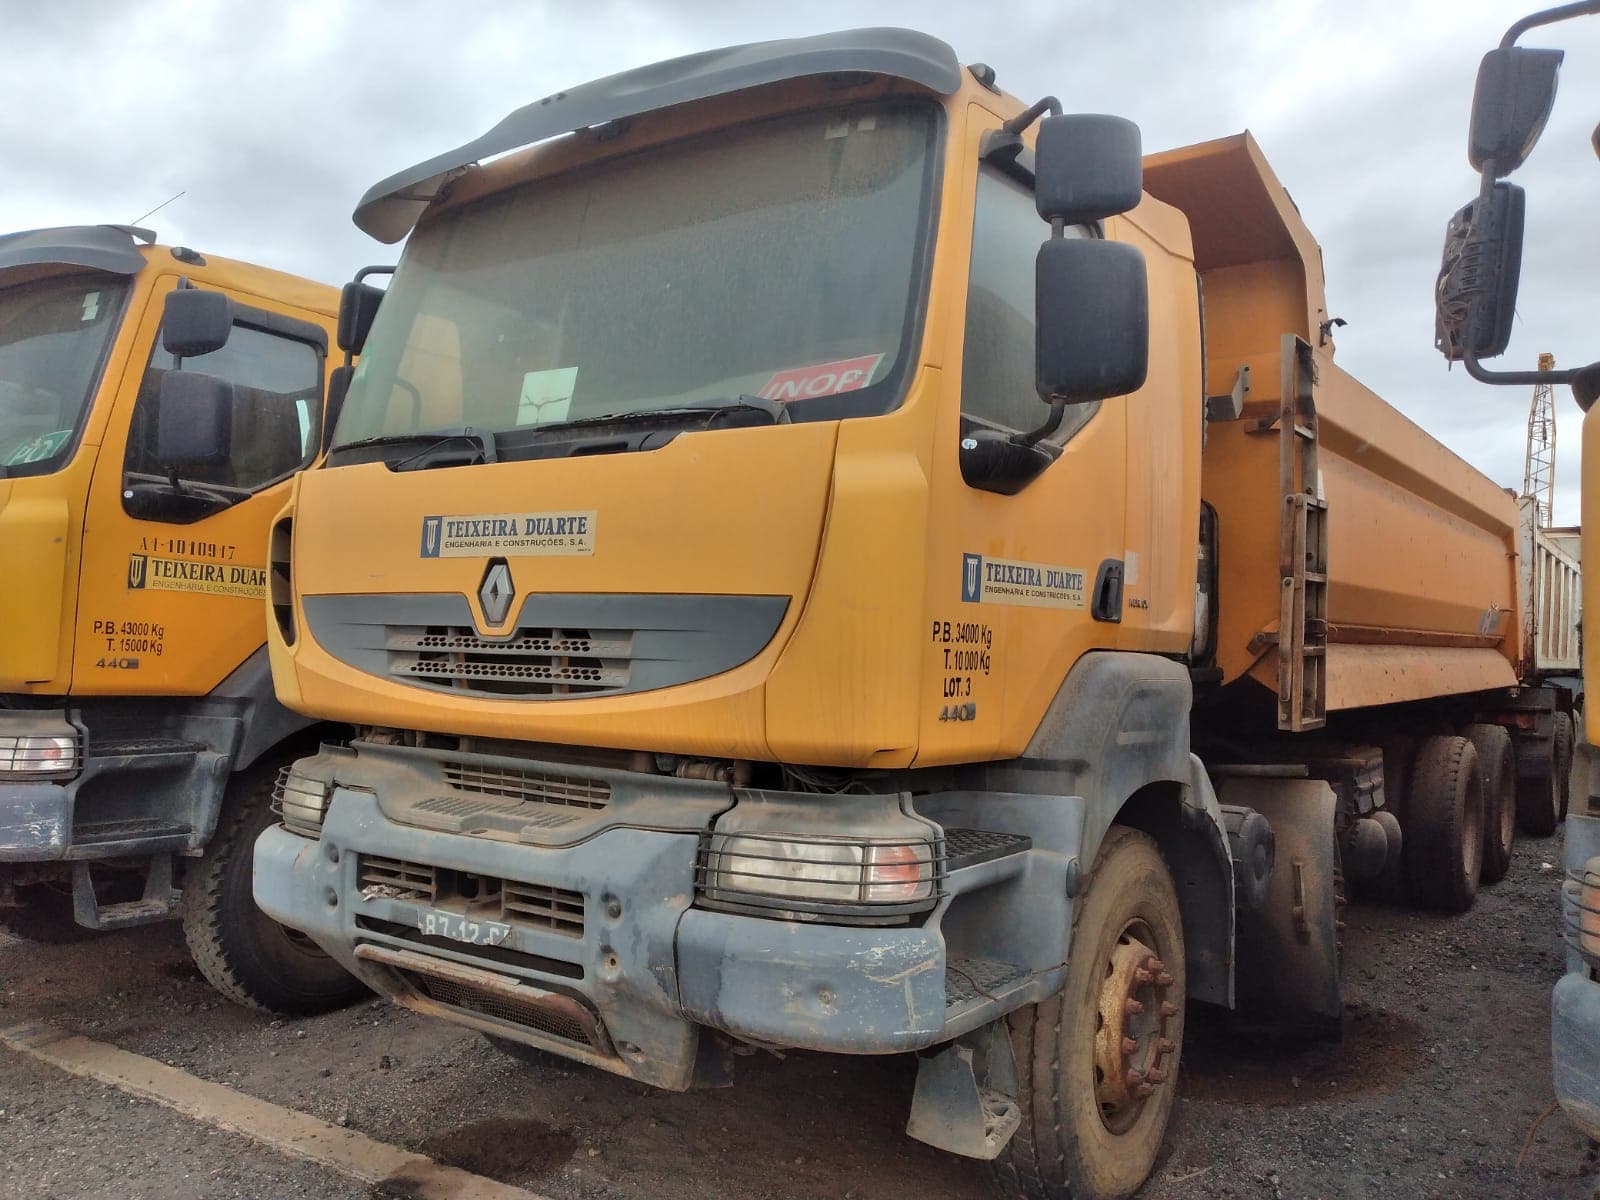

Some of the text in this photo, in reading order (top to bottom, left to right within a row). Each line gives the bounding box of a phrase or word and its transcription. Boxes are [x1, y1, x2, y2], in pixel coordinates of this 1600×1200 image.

[763, 369, 862, 400] INOP
[447, 516, 587, 538] TEIXEIRA DUARTE
[152, 559, 225, 583] TEIXEIRA
[986, 562, 1083, 590] TEIXEIRA DUARTE
[152, 579, 205, 592] ENGENHARIA
[985, 585, 1024, 596] ENGENHARIA
[93, 620, 165, 641] P.B. 43000 Kg
[932, 620, 993, 650] P.B. 34000 Kg
[106, 638, 163, 657] T. 15000 Kg
[943, 648, 952, 670] T.
[980, 651, 991, 676] Kg
[943, 677, 971, 698] LOT. 3
